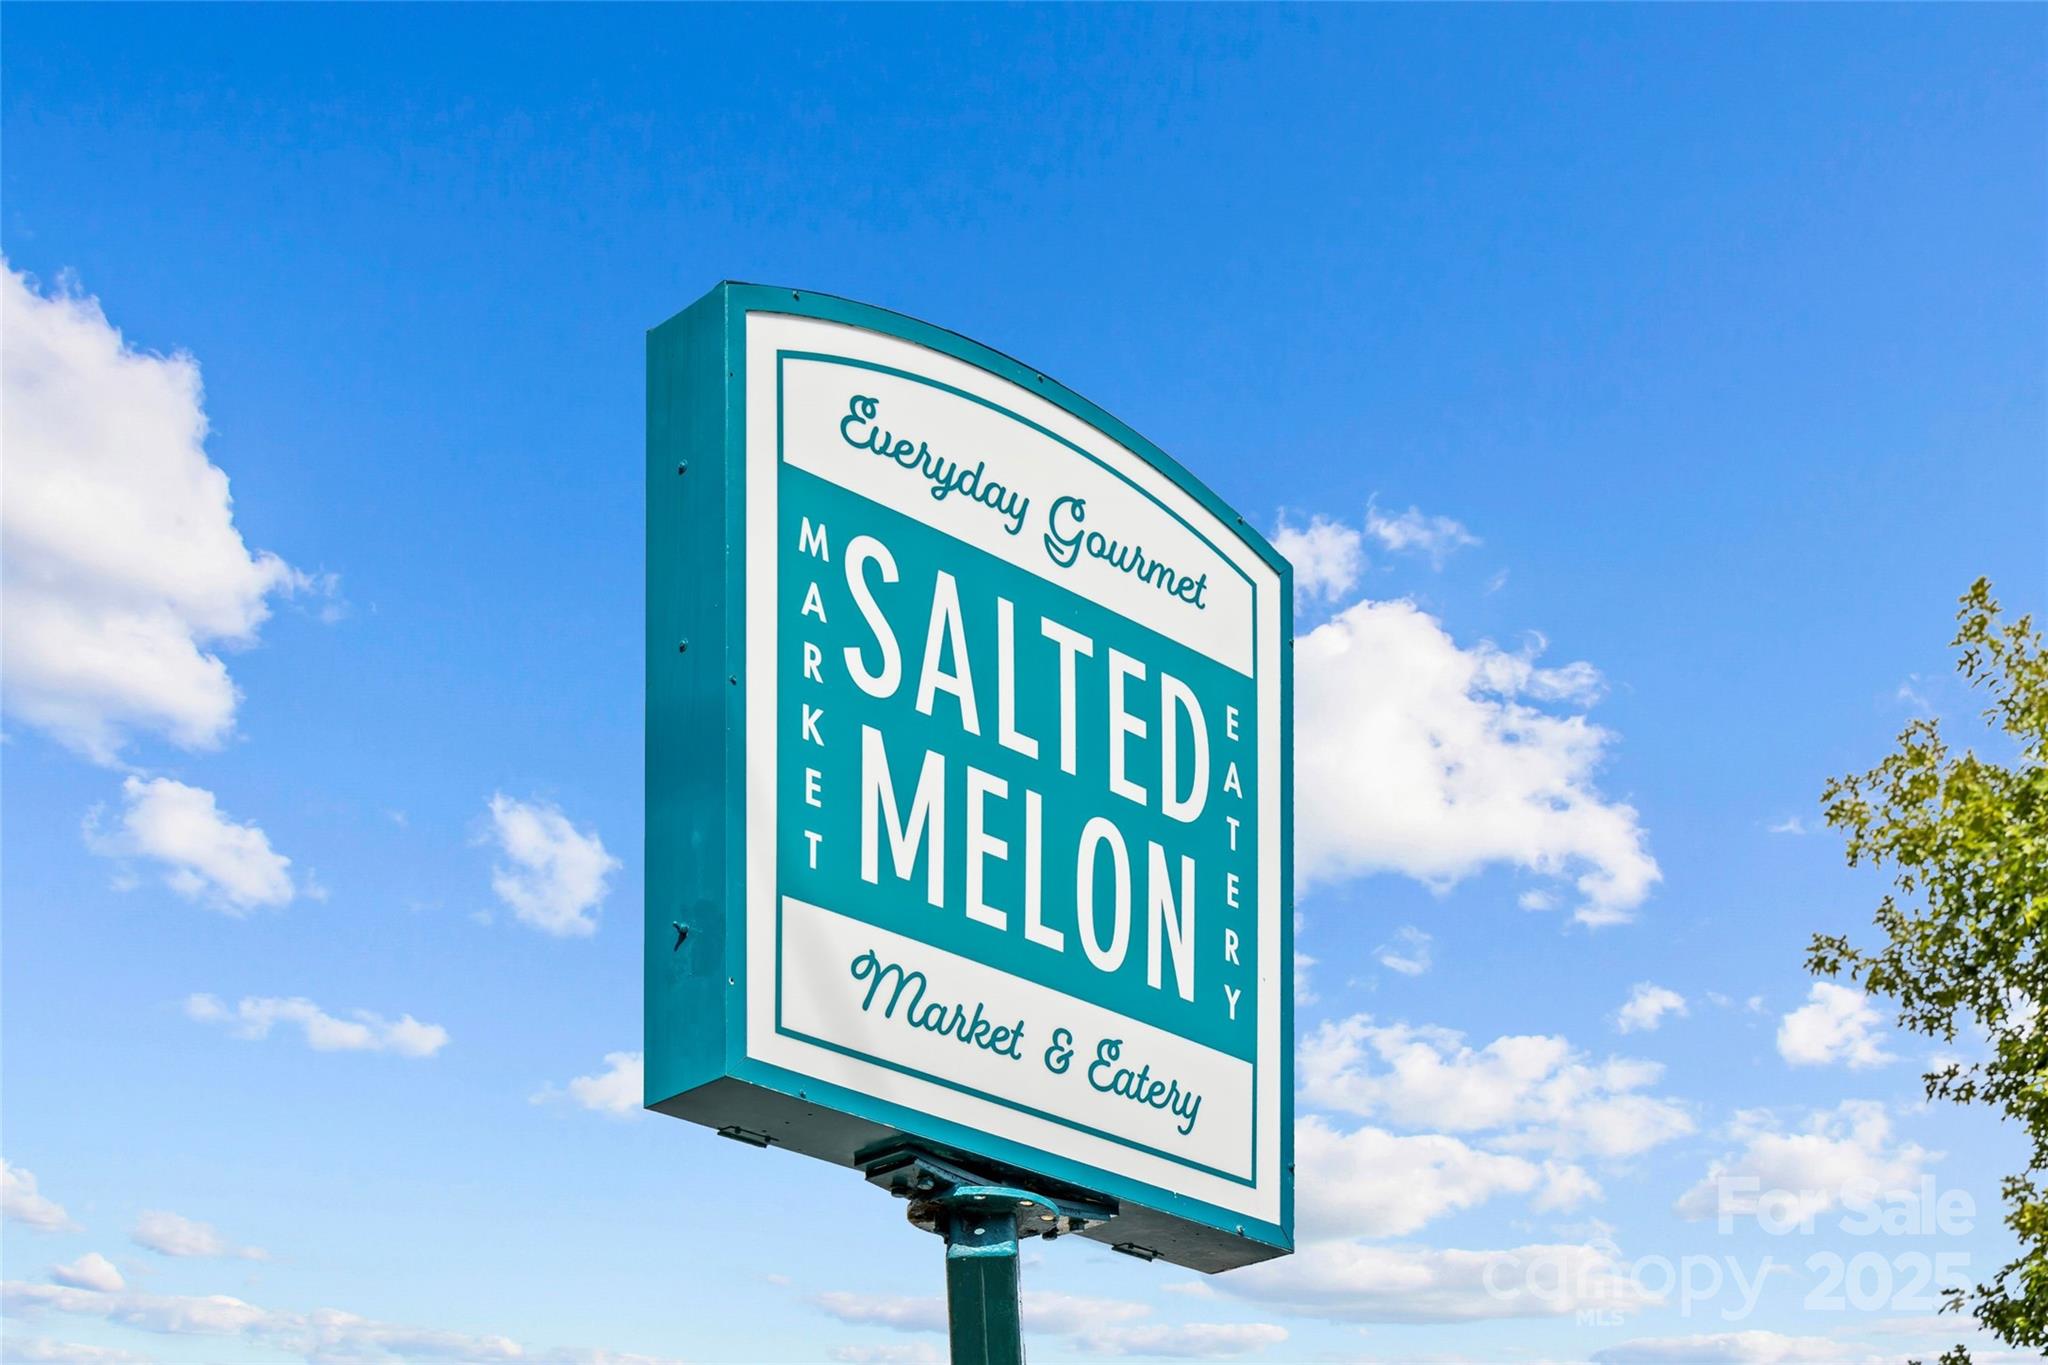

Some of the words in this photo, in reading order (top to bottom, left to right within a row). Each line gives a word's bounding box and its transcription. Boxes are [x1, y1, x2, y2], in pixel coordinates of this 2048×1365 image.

[840, 395, 1029, 535] Everyday
[1044, 495, 1207, 610] Gourmet
[798, 516, 830, 870] MARKET
[843, 535, 1211, 823] SALTED
[861, 724, 1195, 1003] MELON
[1223, 705, 1243, 1021] EATERY
[850, 949, 1025, 1061] Market
[1044, 1027, 1074, 1075] &
[1087, 1038, 1203, 1136] Eatery
